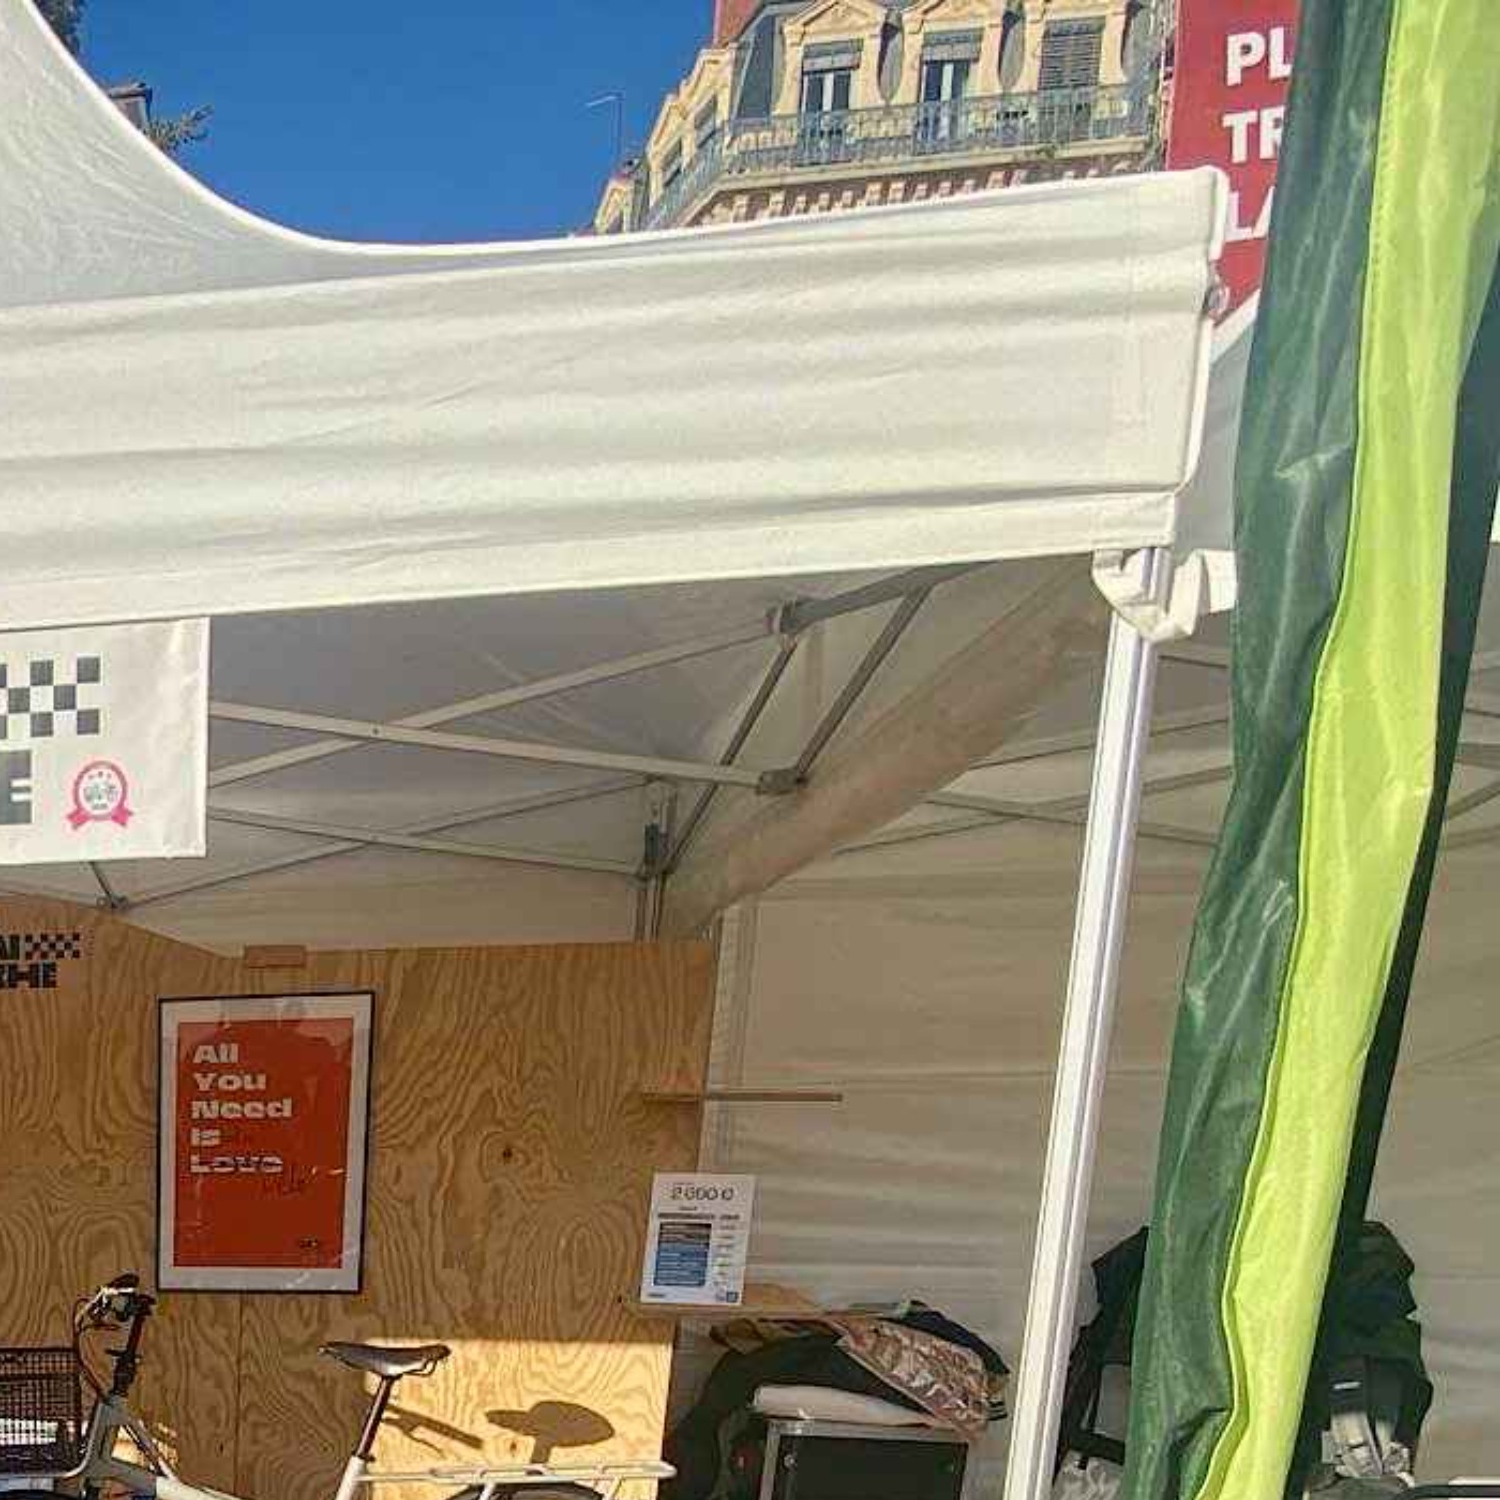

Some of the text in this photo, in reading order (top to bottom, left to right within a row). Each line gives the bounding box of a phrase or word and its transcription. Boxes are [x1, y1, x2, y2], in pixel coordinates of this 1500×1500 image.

[192, 1042, 239, 1064] All
[192, 1072, 267, 1092] You
[190, 1097, 293, 1120] Need
